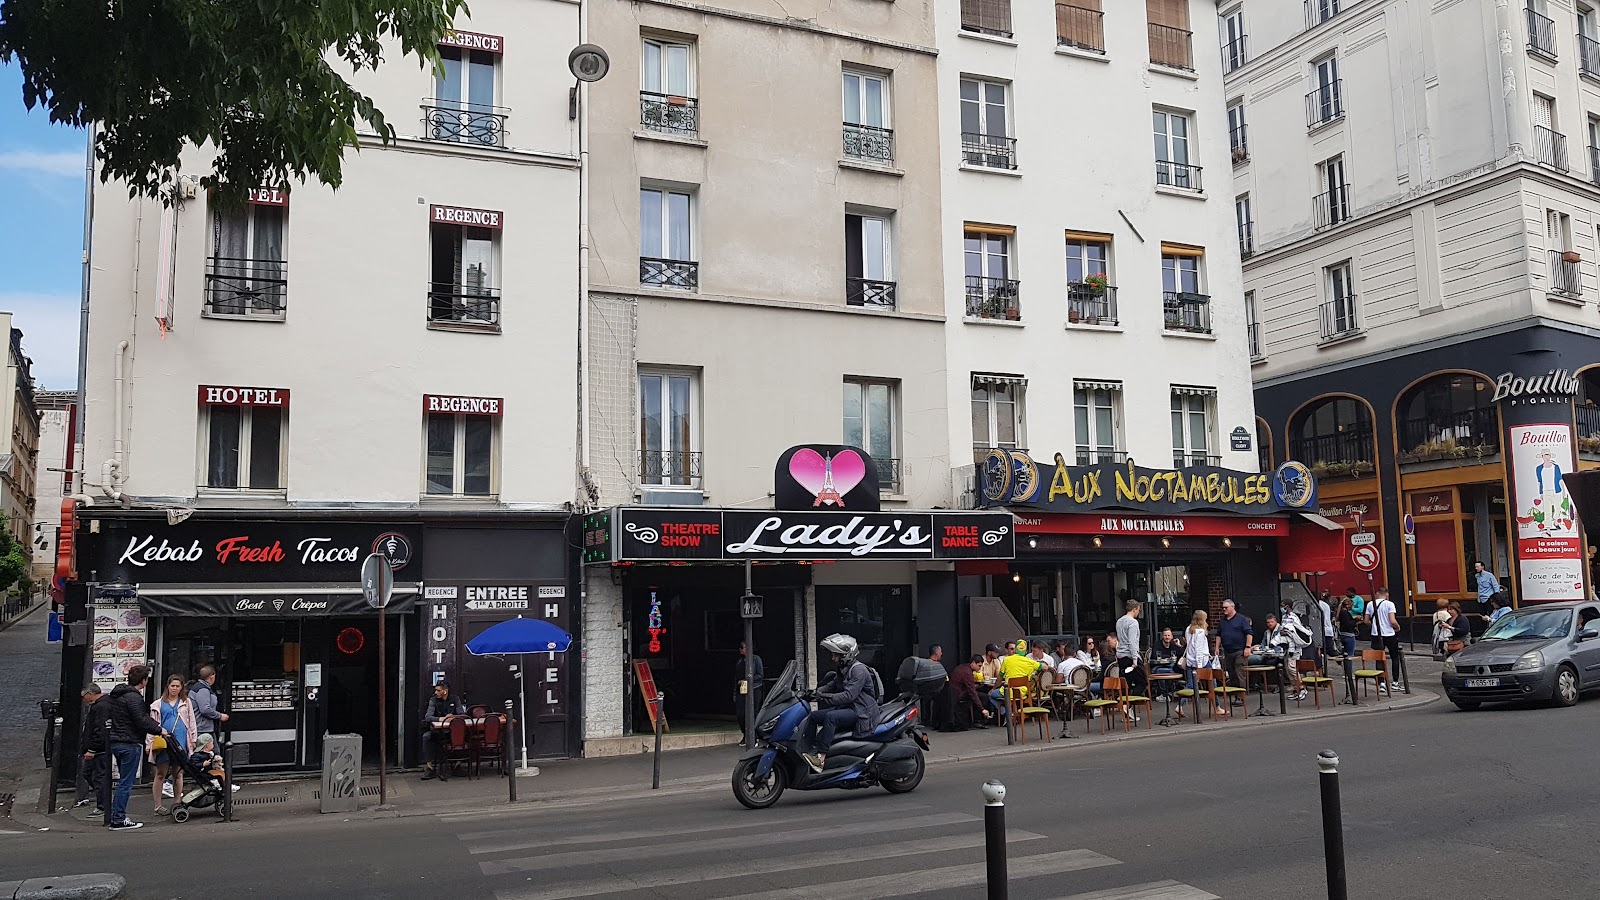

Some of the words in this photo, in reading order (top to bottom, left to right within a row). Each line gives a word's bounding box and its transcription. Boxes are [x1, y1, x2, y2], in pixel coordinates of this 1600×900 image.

[435, 207, 499, 226] REGENCE
[1491, 369, 1580, 402] Bouillon
[206, 388, 282, 405] HOTEL
[1512, 397, 1568, 406] PIGALLE
[429, 397, 499, 413] REGENCE
[1520, 431, 1567, 446] Bouillon
[661, 523, 720, 535] THEATRE
[943, 525, 979, 536] TABLE
[1101, 518, 1119, 531] AUX
[1121, 518, 1185, 531] NOCTAMBULES
[661, 536, 701, 547] SHOW
[726, 515, 931, 556] Lady's
[942, 537, 979, 547] DANCE
[118, 534, 203, 567] Kebab
[215, 535, 286, 565] Fresh
[296, 537, 359, 565] Tacos
[1255, 544, 1263, 552] 24
[428, 588, 455, 596] REGENCE
[466, 586, 528, 600] ENTREE
[540, 586, 564, 595] REGENCE
[891, 587, 901, 596] 26
[235, 598, 267, 611] Best
[291, 597, 328, 612] Crêpes
[495, 601, 526, 609] DROITE
[432, 604, 447, 686] HOTE
